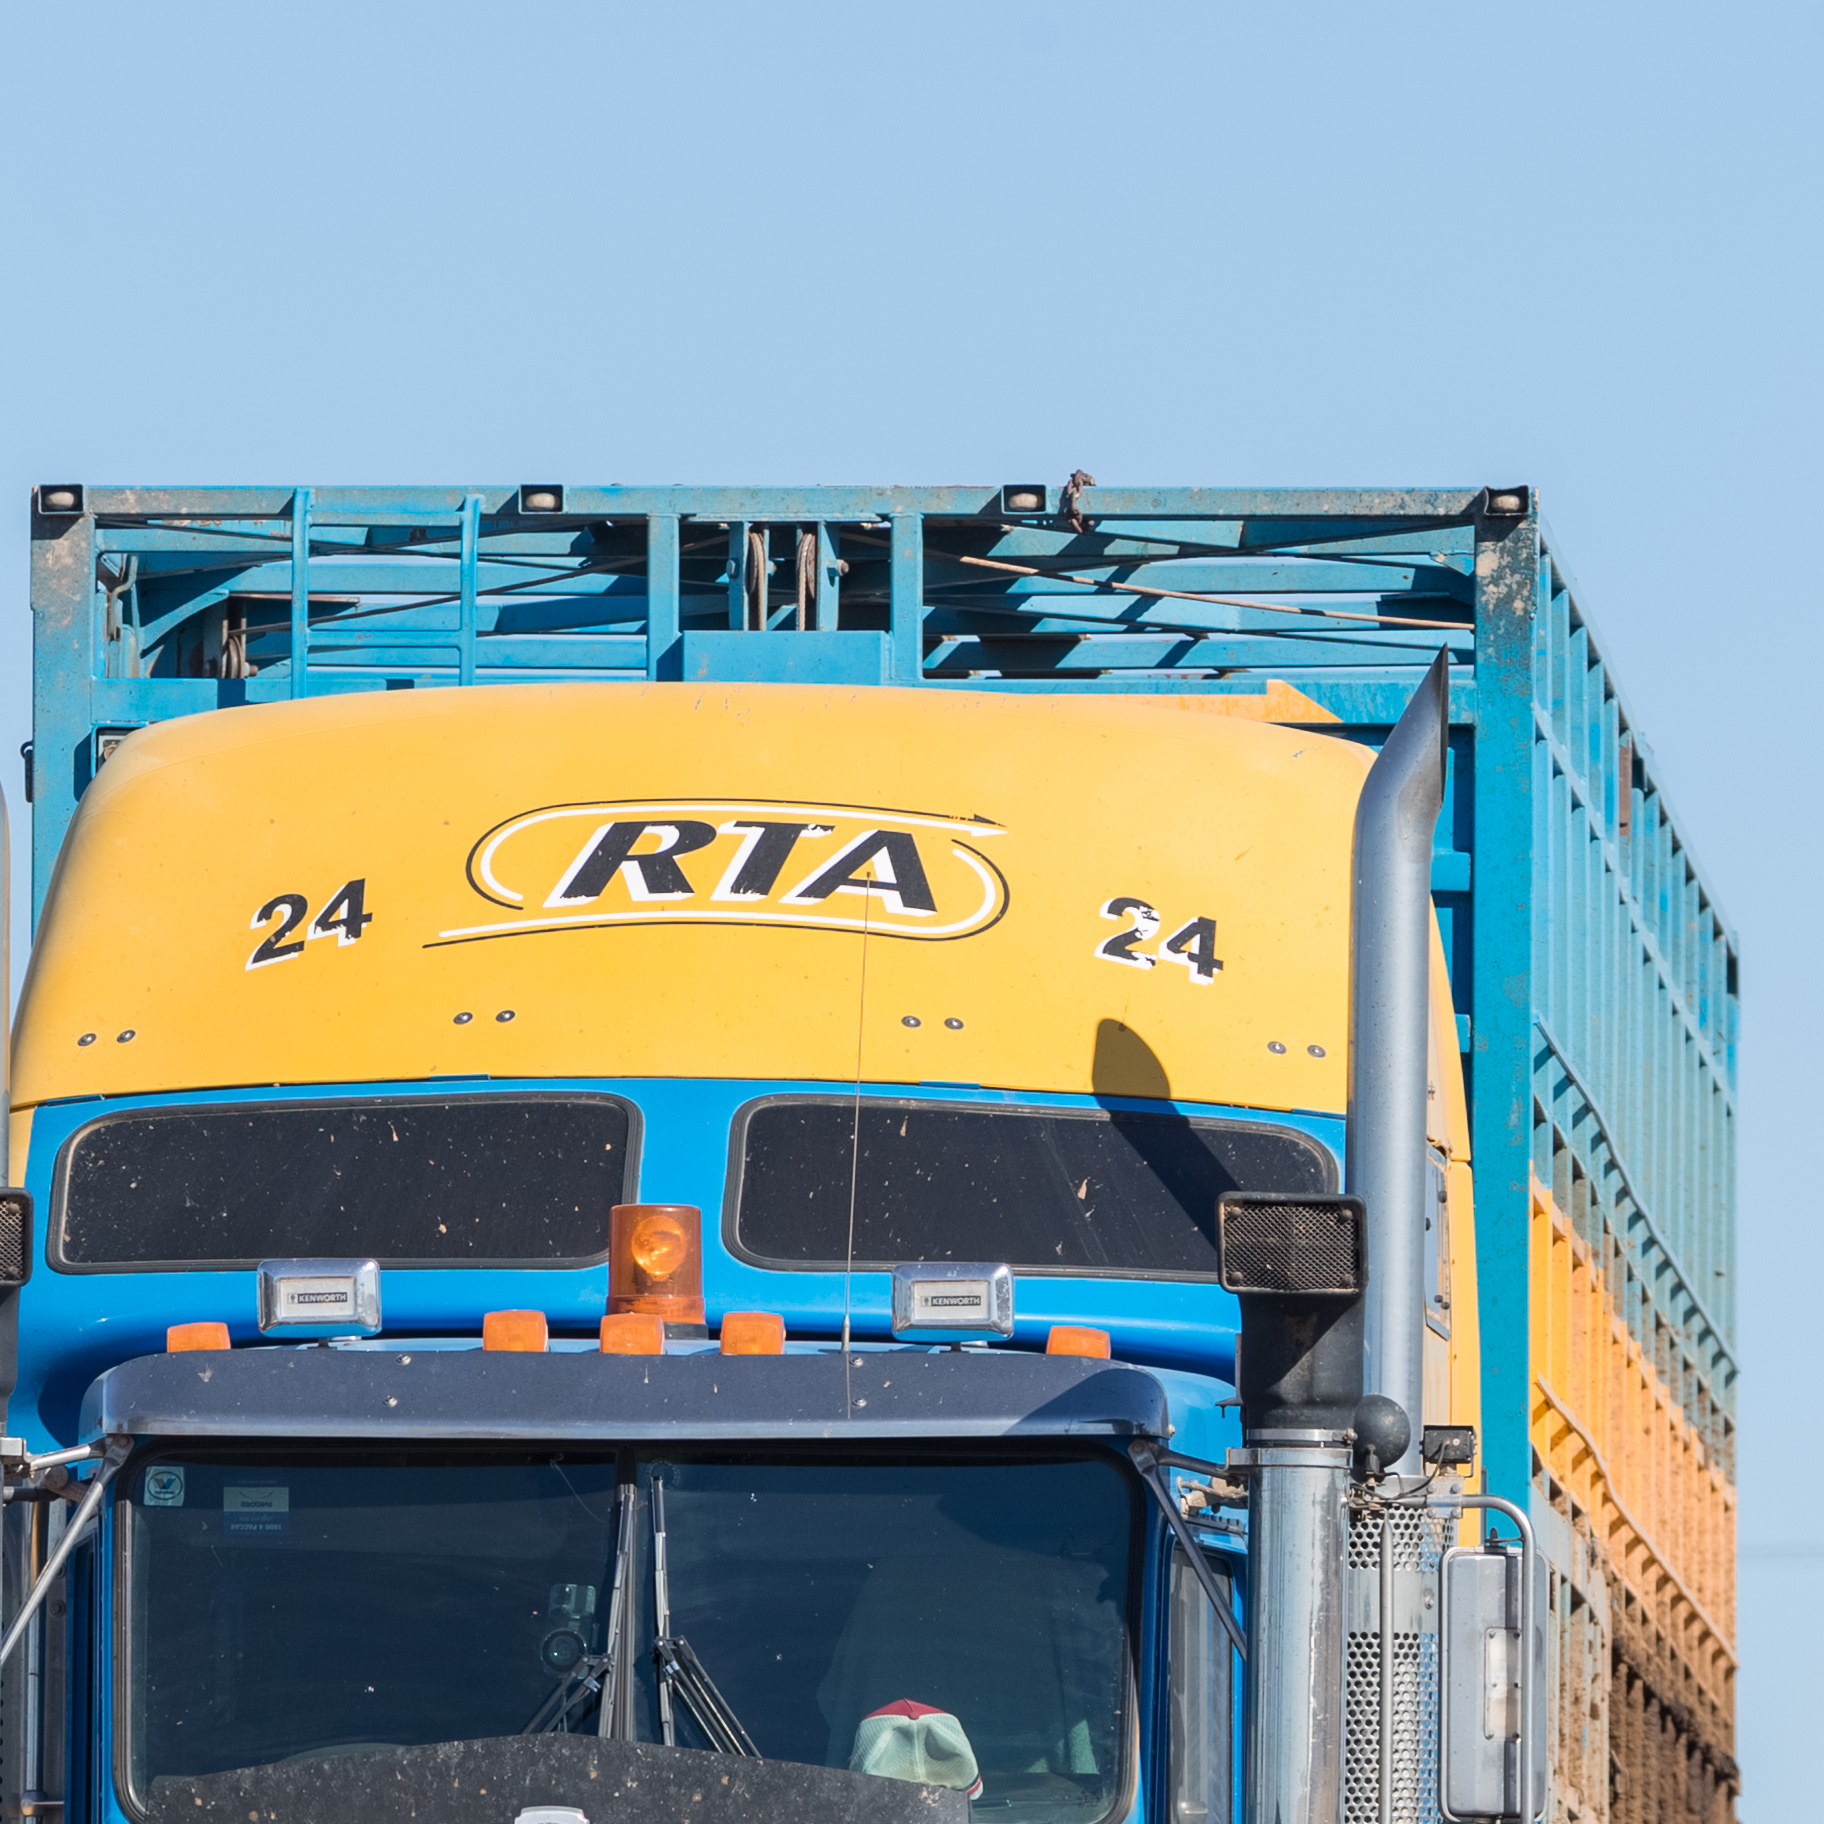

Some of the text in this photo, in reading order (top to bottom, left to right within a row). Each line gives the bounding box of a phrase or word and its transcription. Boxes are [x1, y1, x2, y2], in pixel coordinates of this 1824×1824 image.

[543, 819, 937, 918] RTA
[245, 877, 373, 971] 24
[1094, 896, 1224, 986] 24
[298, 1293, 347, 1303] KENWORTH
[932, 1296, 980, 1306] KENWORTH
